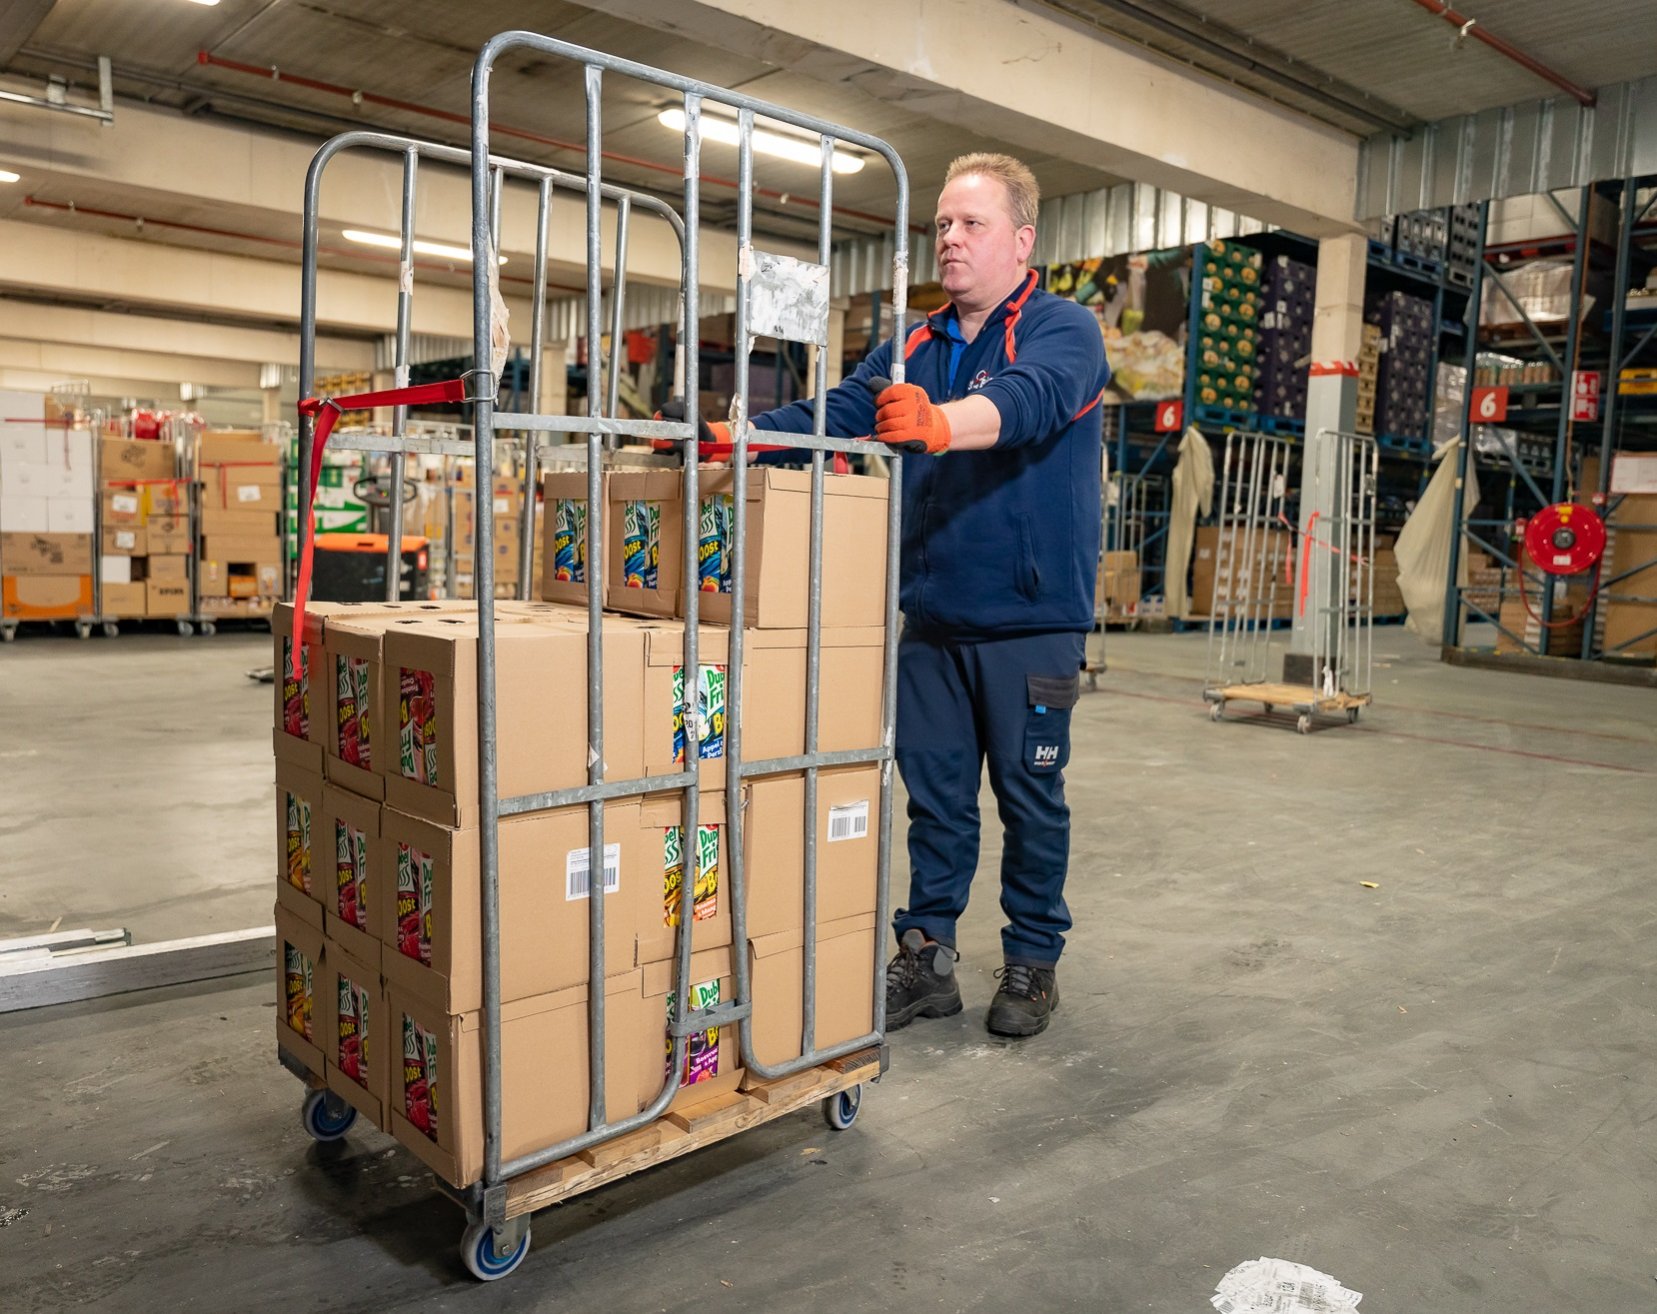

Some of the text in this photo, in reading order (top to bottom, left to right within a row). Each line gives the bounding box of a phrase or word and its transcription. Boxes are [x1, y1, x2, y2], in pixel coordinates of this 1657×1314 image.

[1480, 391, 1496, 418] 6
[1162, 405, 1175, 428] 6
[1035, 746, 1059, 760] HH
